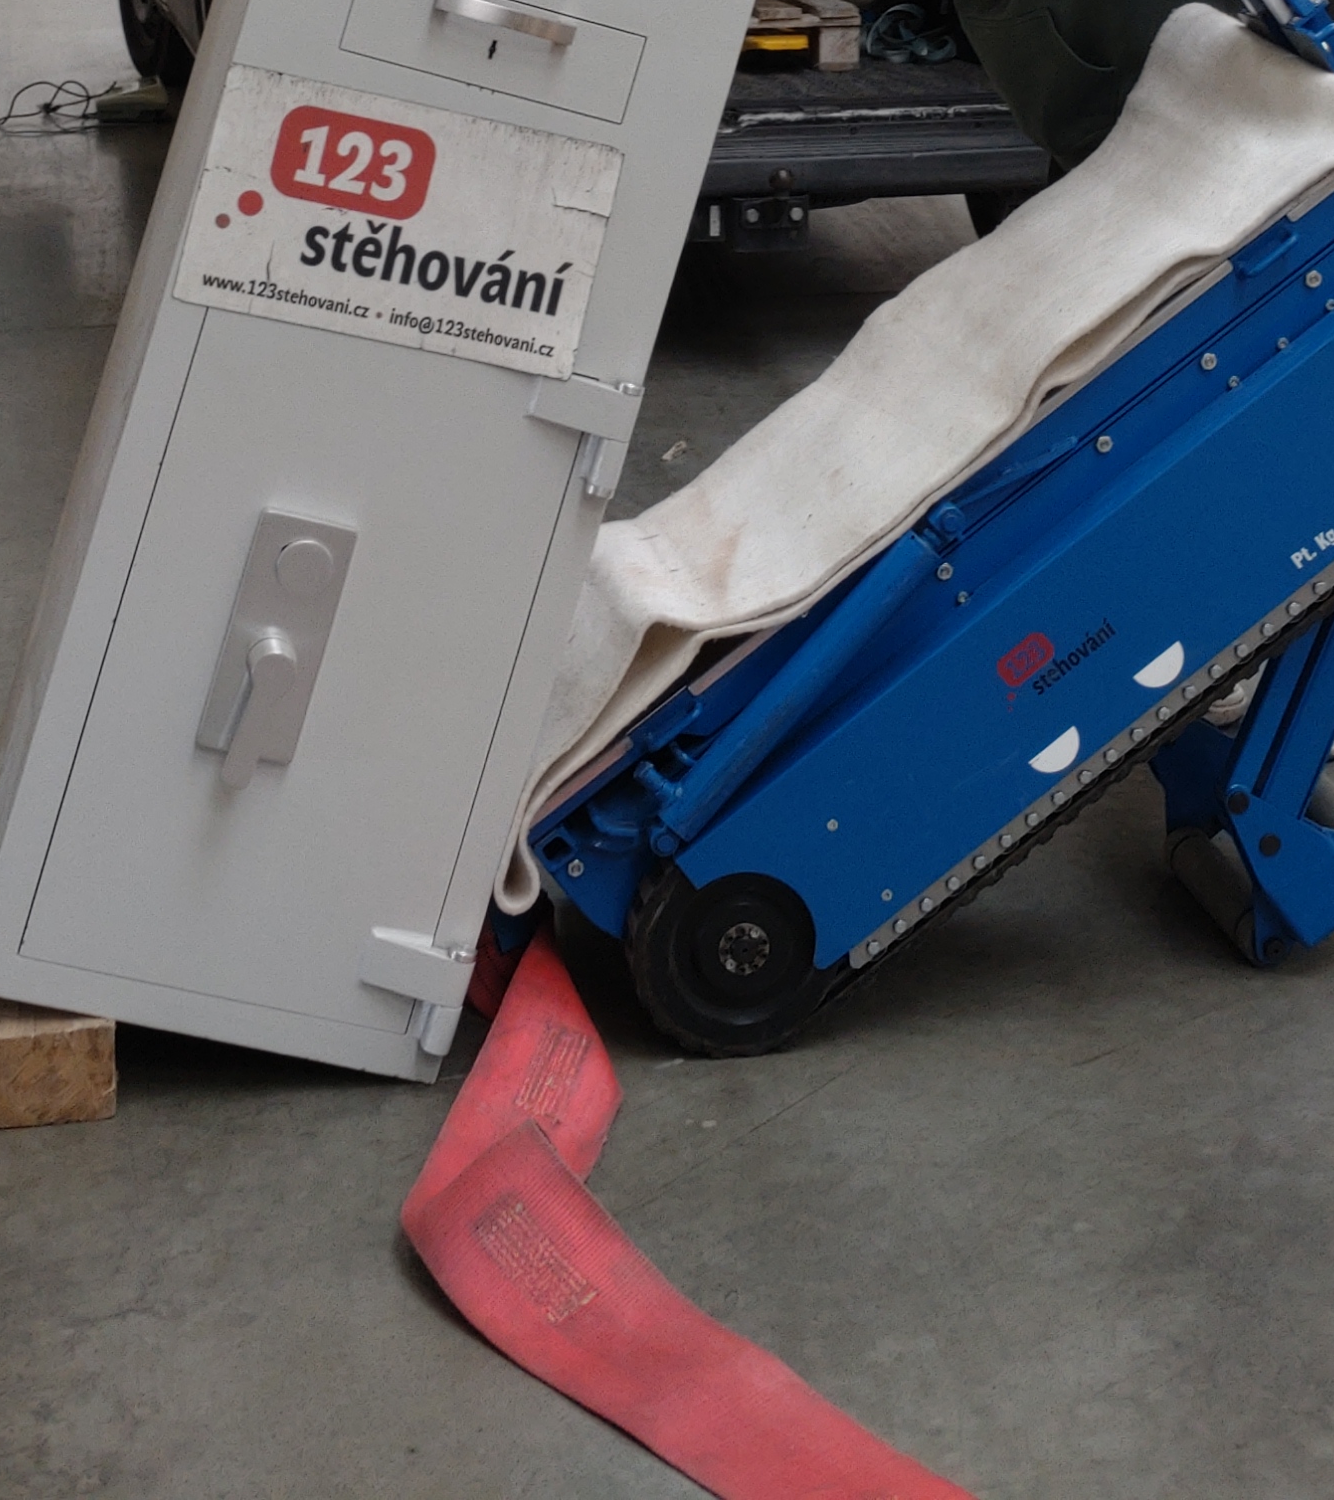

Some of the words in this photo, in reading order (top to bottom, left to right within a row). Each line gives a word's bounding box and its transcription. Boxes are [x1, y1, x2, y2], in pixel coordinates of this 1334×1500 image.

[293, 125, 413, 201] 123
[300, 219, 573, 316] stěhování
[202, 273, 370, 319] www.123stehovani.cz
[388, 308, 555, 357] info@123stehovani.cz
[1290, 547, 1317, 569] Pt.
[1005, 641, 1046, 678] 123
